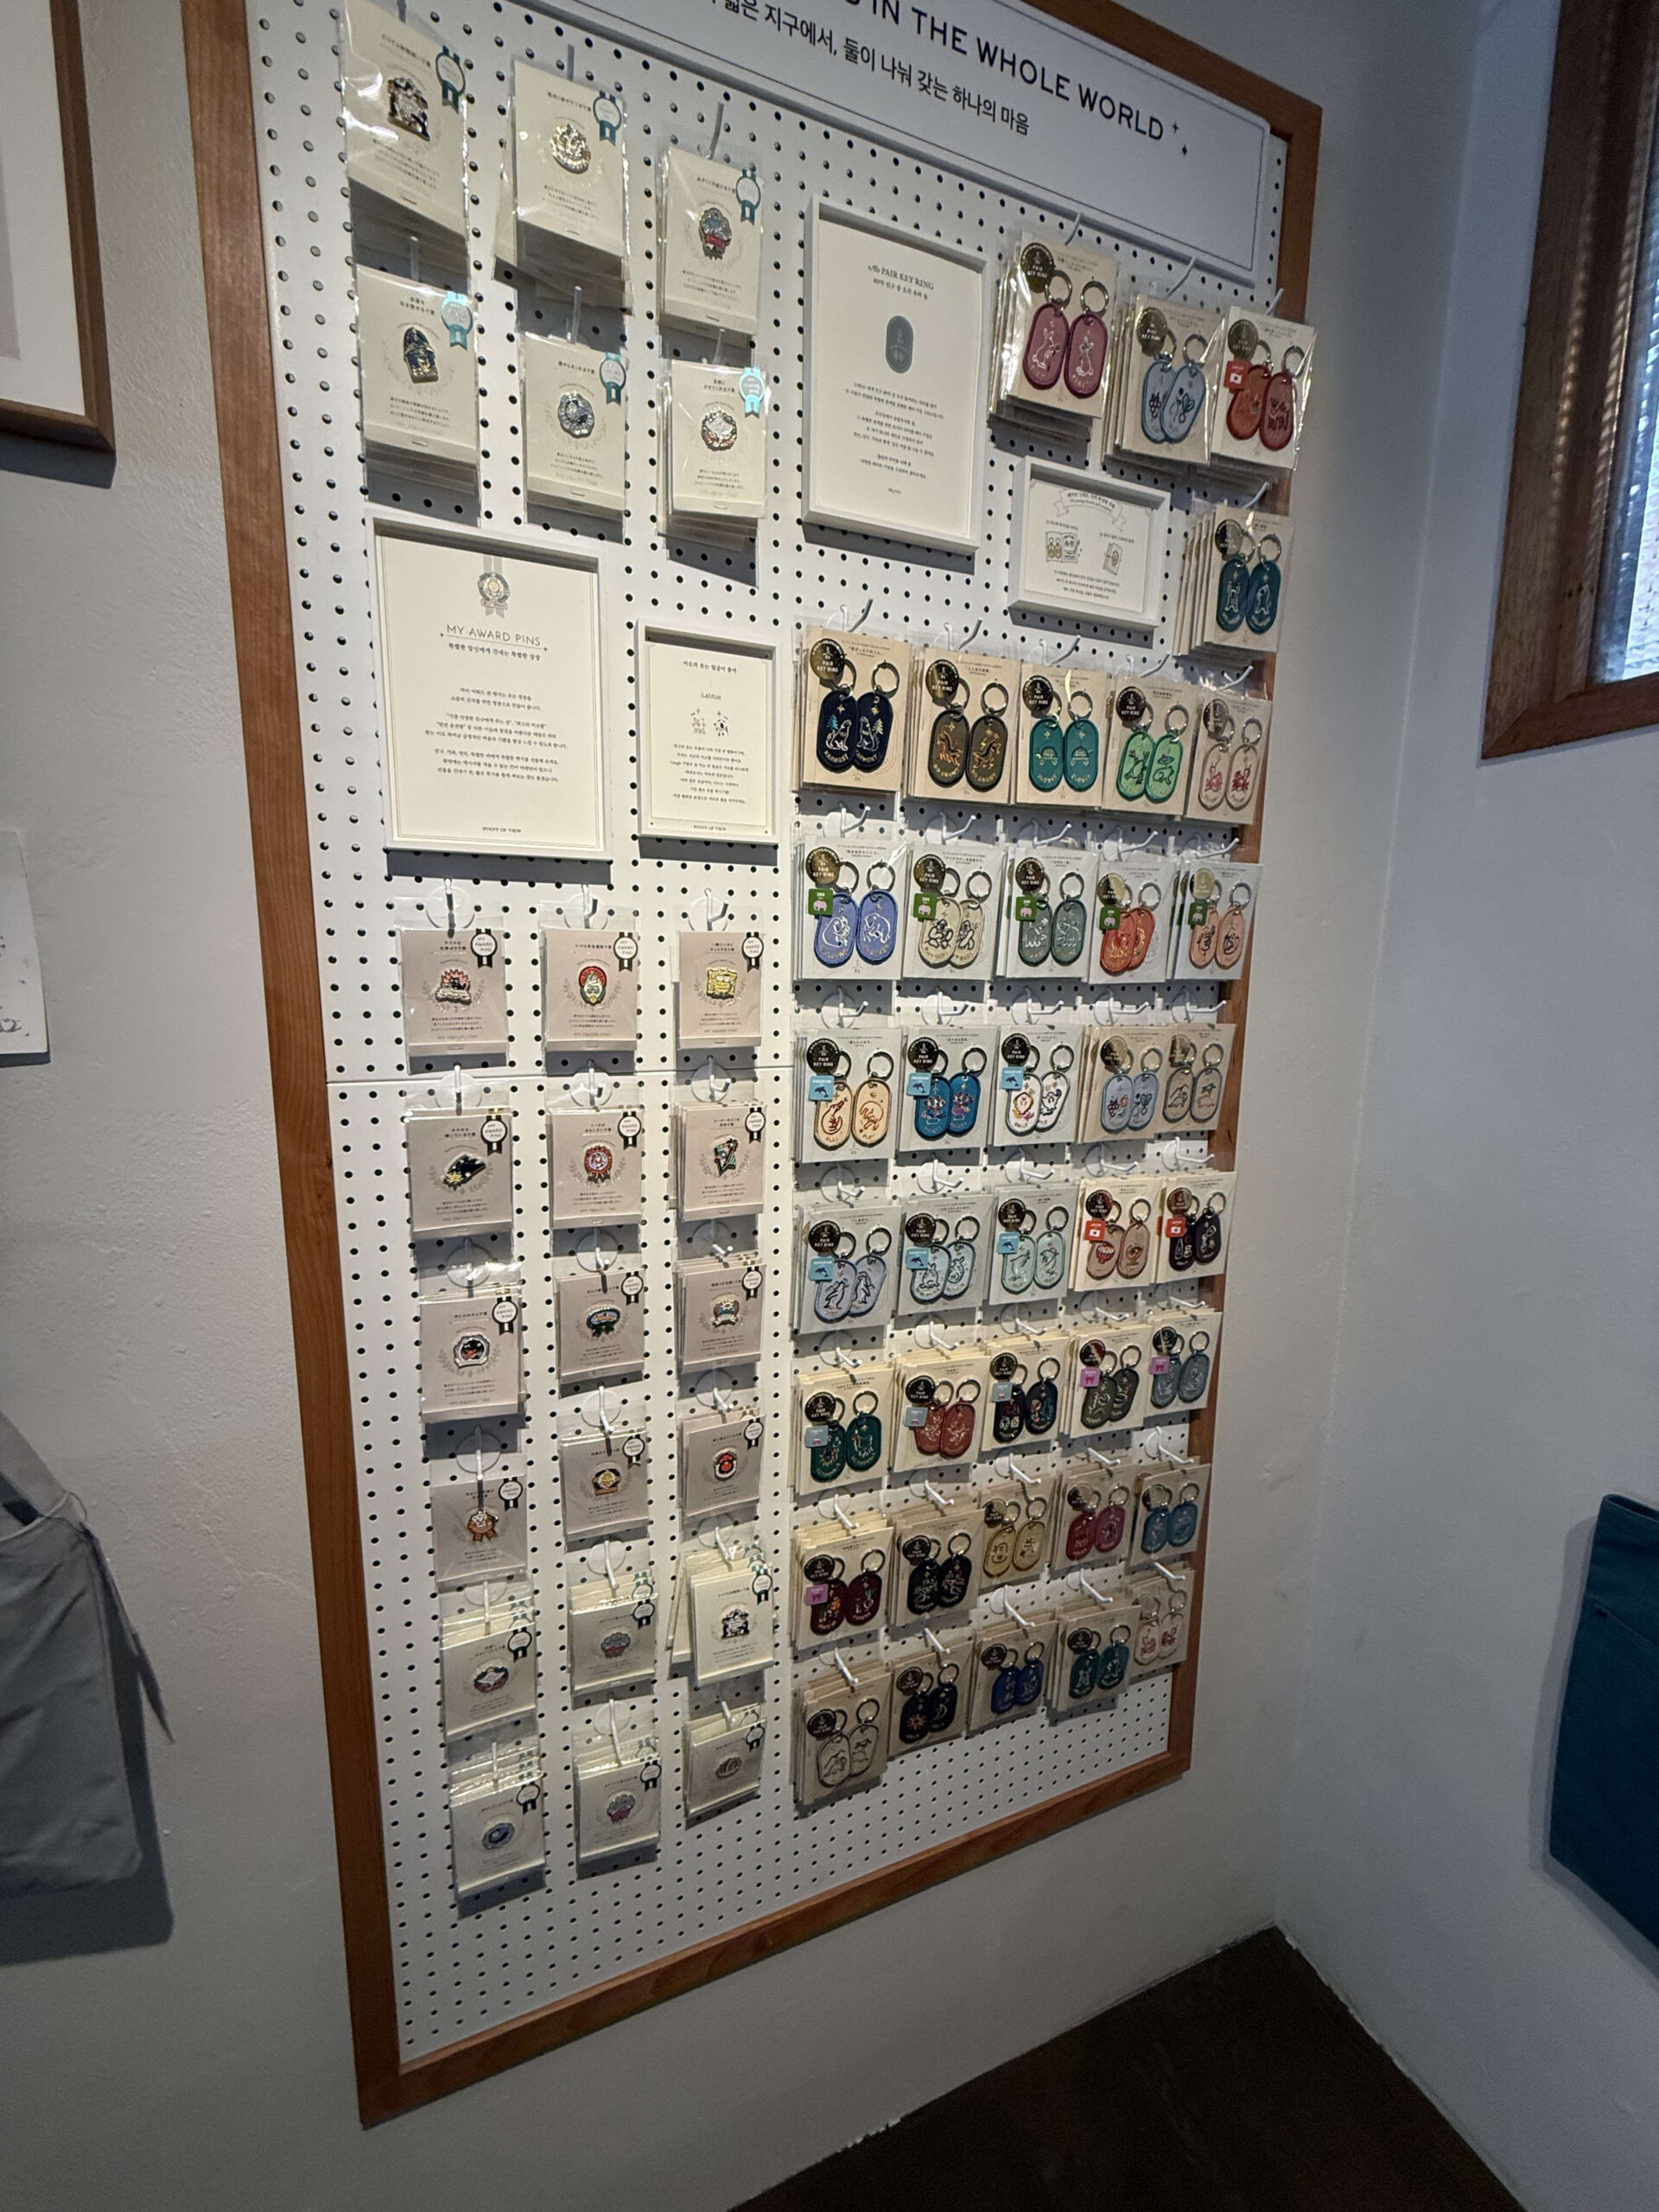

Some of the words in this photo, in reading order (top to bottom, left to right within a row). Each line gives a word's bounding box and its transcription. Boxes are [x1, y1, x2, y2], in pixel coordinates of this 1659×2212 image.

[765, 3, 837, 56] 지구에서,
[843, 37, 875, 72] 둘이
[881, 54, 912, 87] 나눠
[918, 70, 949, 101] 갖는
[952, 86, 996, 123] 하나의
[1001, 106, 1029, 136] 마음
[912, 6, 968, 55] THE
[976, 36, 1071, 102] WHOLE
[1078, 83, 1164, 140] WORLD
[881, 267, 899, 279] PAIR
[899, 273, 914, 283] KEY
[915, 277, 934, 290] RING
[447, 625, 465, 635] MY
[469, 627, 511, 642] AWARD
[448, 642, 466, 651] 특별한
[467, 645, 491, 654] 당신에게
[511, 651, 528, 659] 특별한
